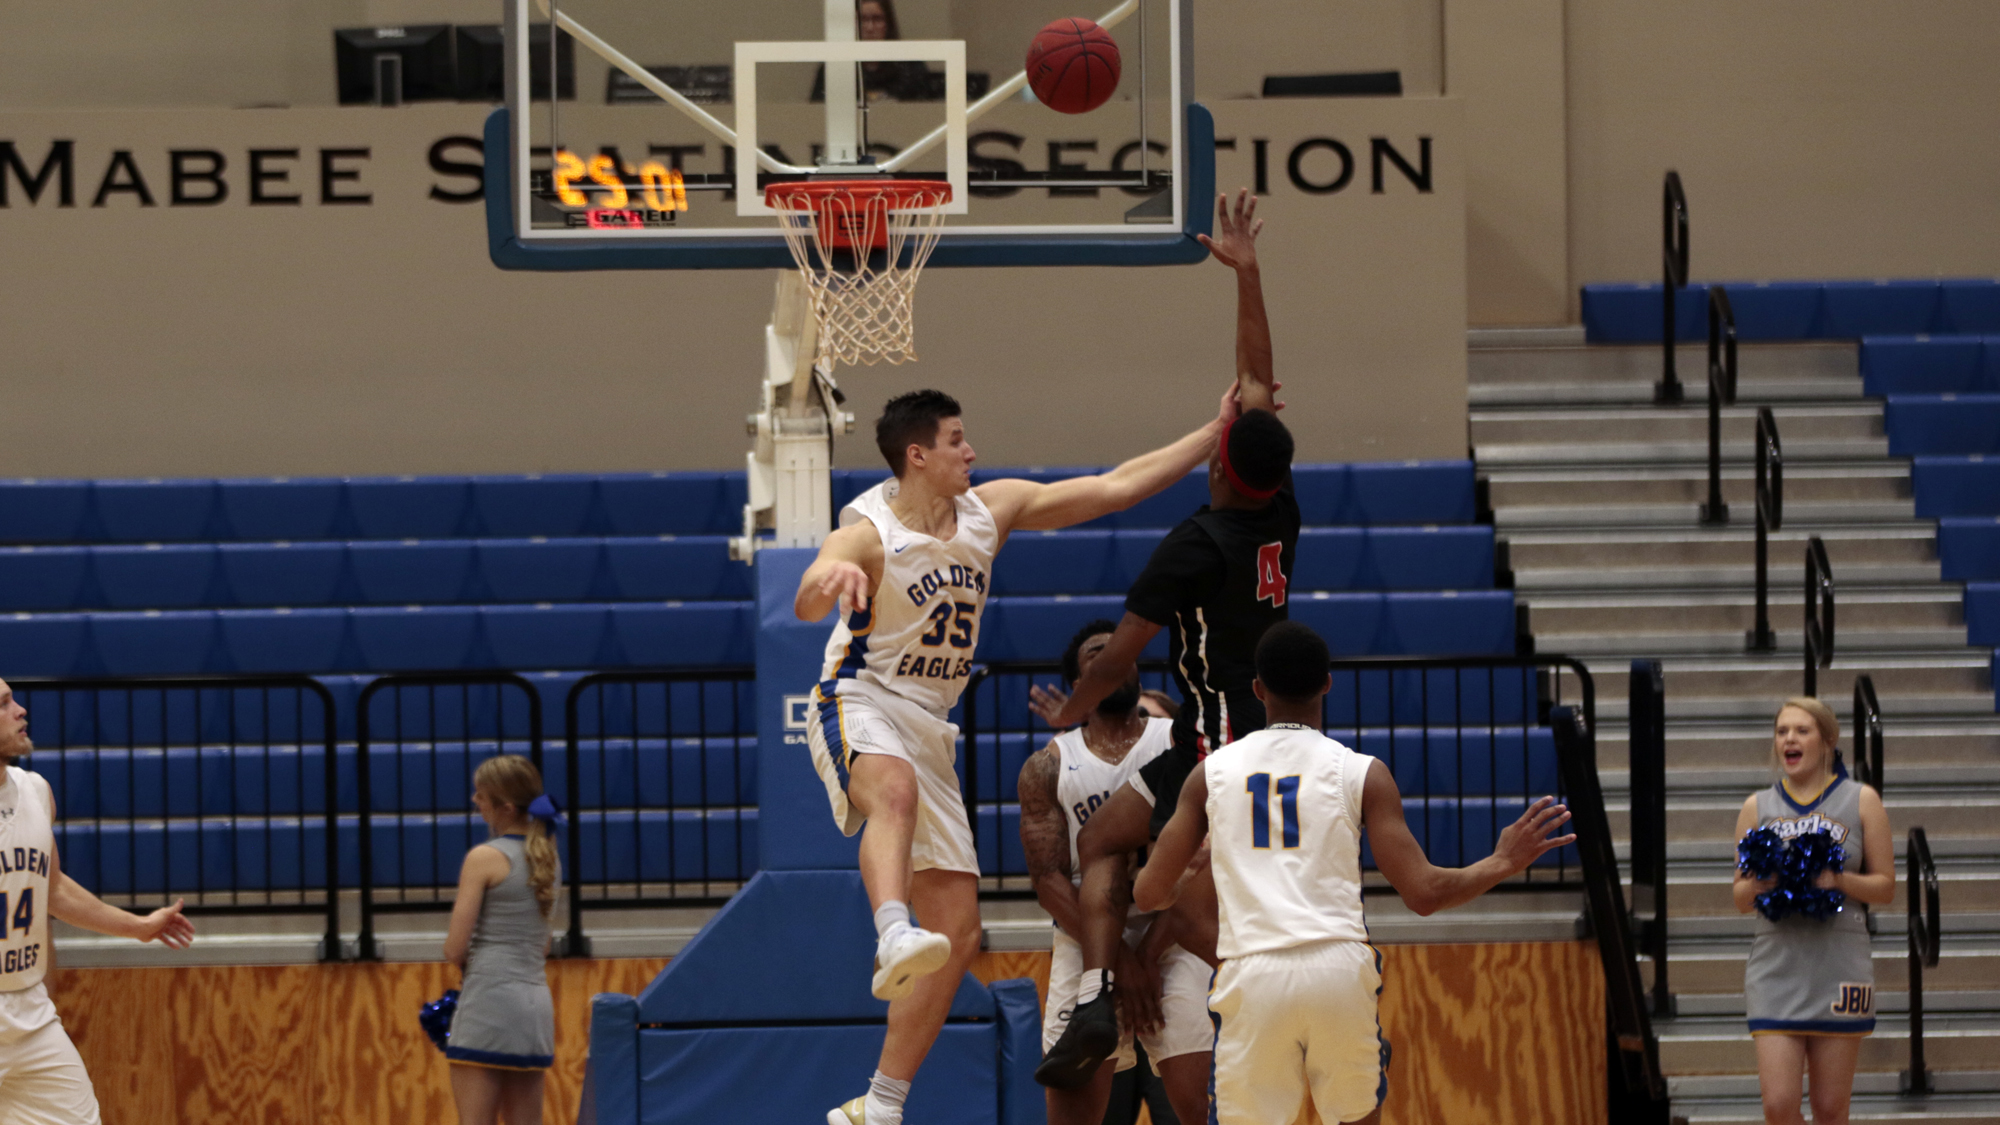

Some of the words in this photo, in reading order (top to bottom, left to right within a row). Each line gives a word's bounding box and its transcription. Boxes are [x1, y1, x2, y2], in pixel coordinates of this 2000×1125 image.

[0, 140, 373, 208] MABEE
[966, 131, 1435, 200] SECION
[594, 209, 676, 222] GARED
[907, 565, 986, 607] GOLDEN
[1257, 541, 1287, 608] 4
[921, 602, 977, 650] 35
[897, 654, 974, 680] EAGLES
[1246, 772, 1301, 850] 11
[0, 847, 49, 878] LDEN
[0, 887, 34, 941] 14
[0, 943, 40, 975] GLES
[1831, 983, 1873, 1016] JBU
